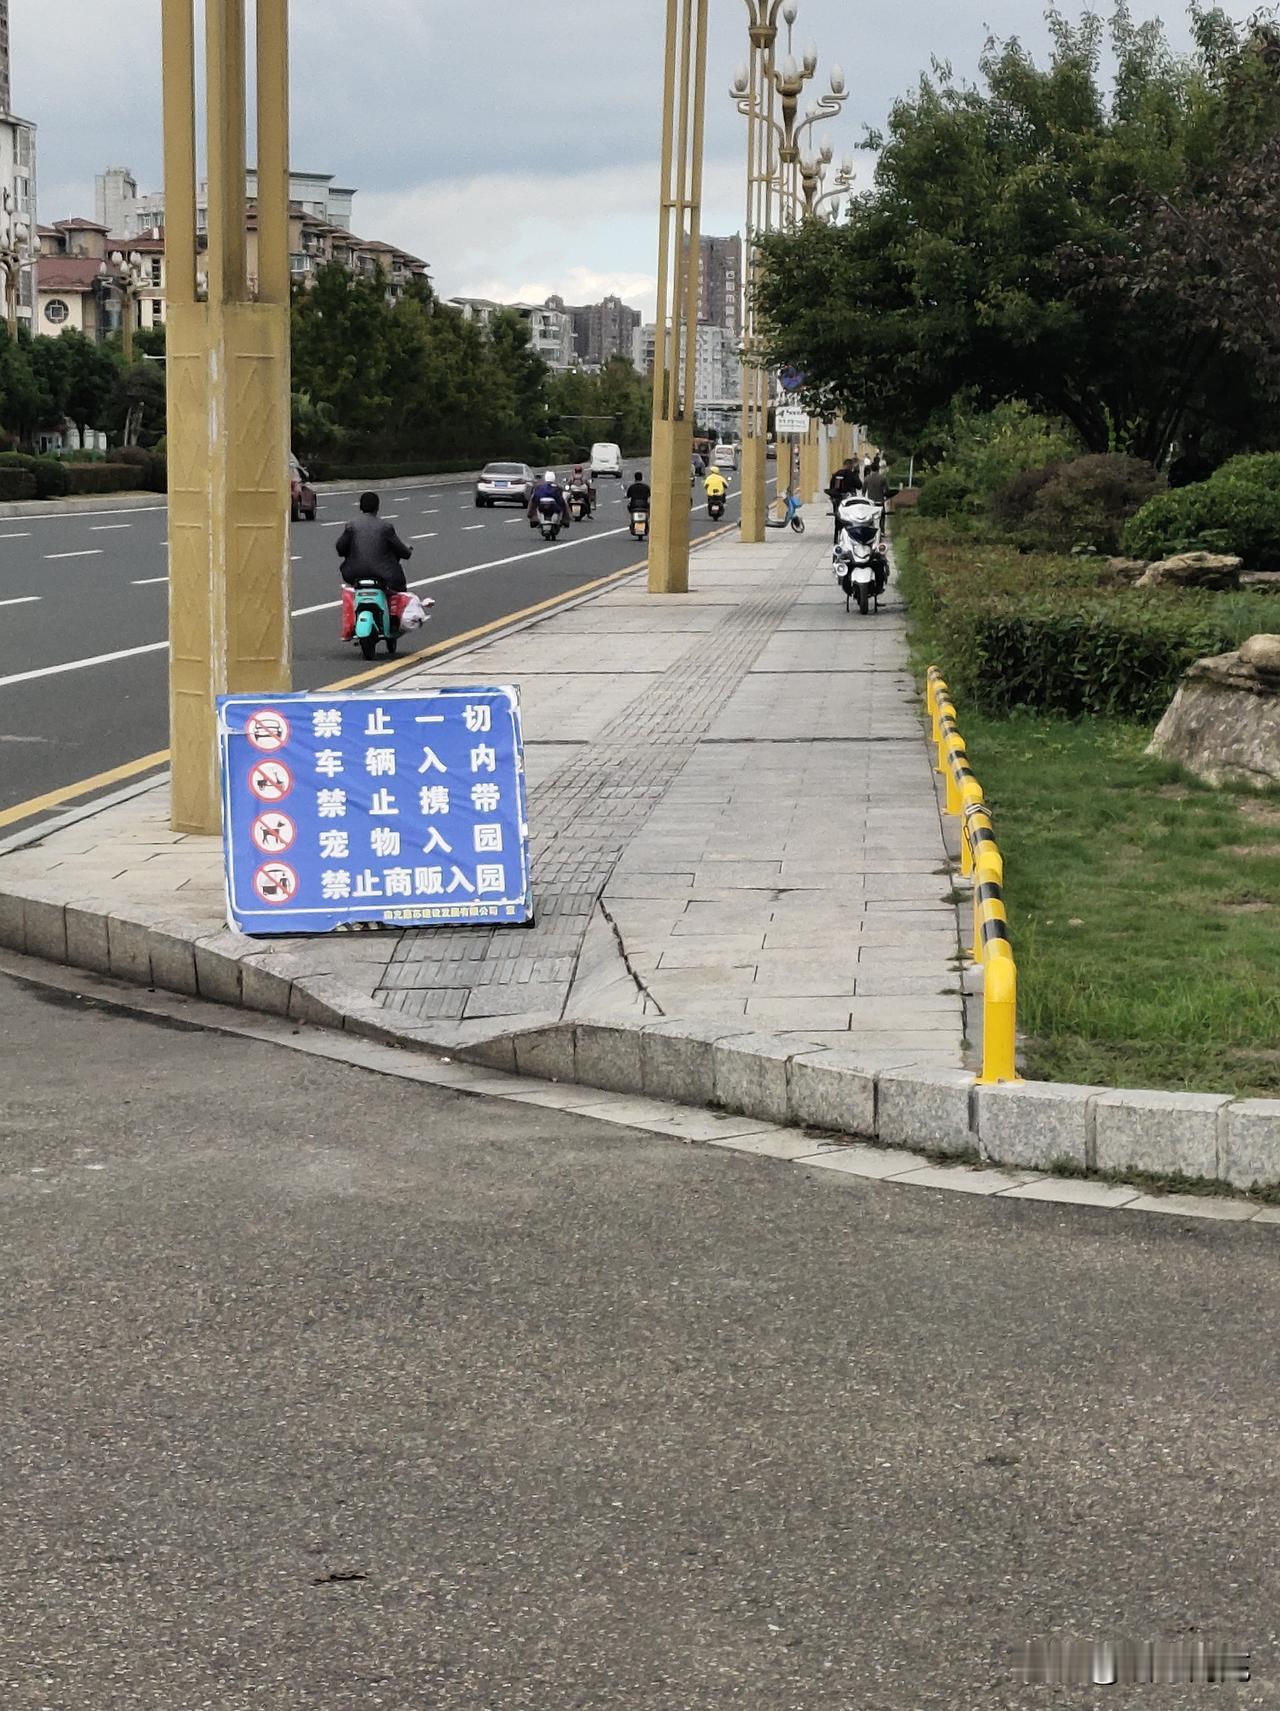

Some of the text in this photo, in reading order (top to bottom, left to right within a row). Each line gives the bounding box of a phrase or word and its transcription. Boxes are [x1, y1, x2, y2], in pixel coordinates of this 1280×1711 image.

[312, 704, 492, 738] 禁止一切
[314, 743, 496, 778] 车辆入内
[316, 783, 501, 819] 禁止携带
[318, 823, 504, 859] 宠物入园
[320, 863, 506, 900] 禁止商贩入园
